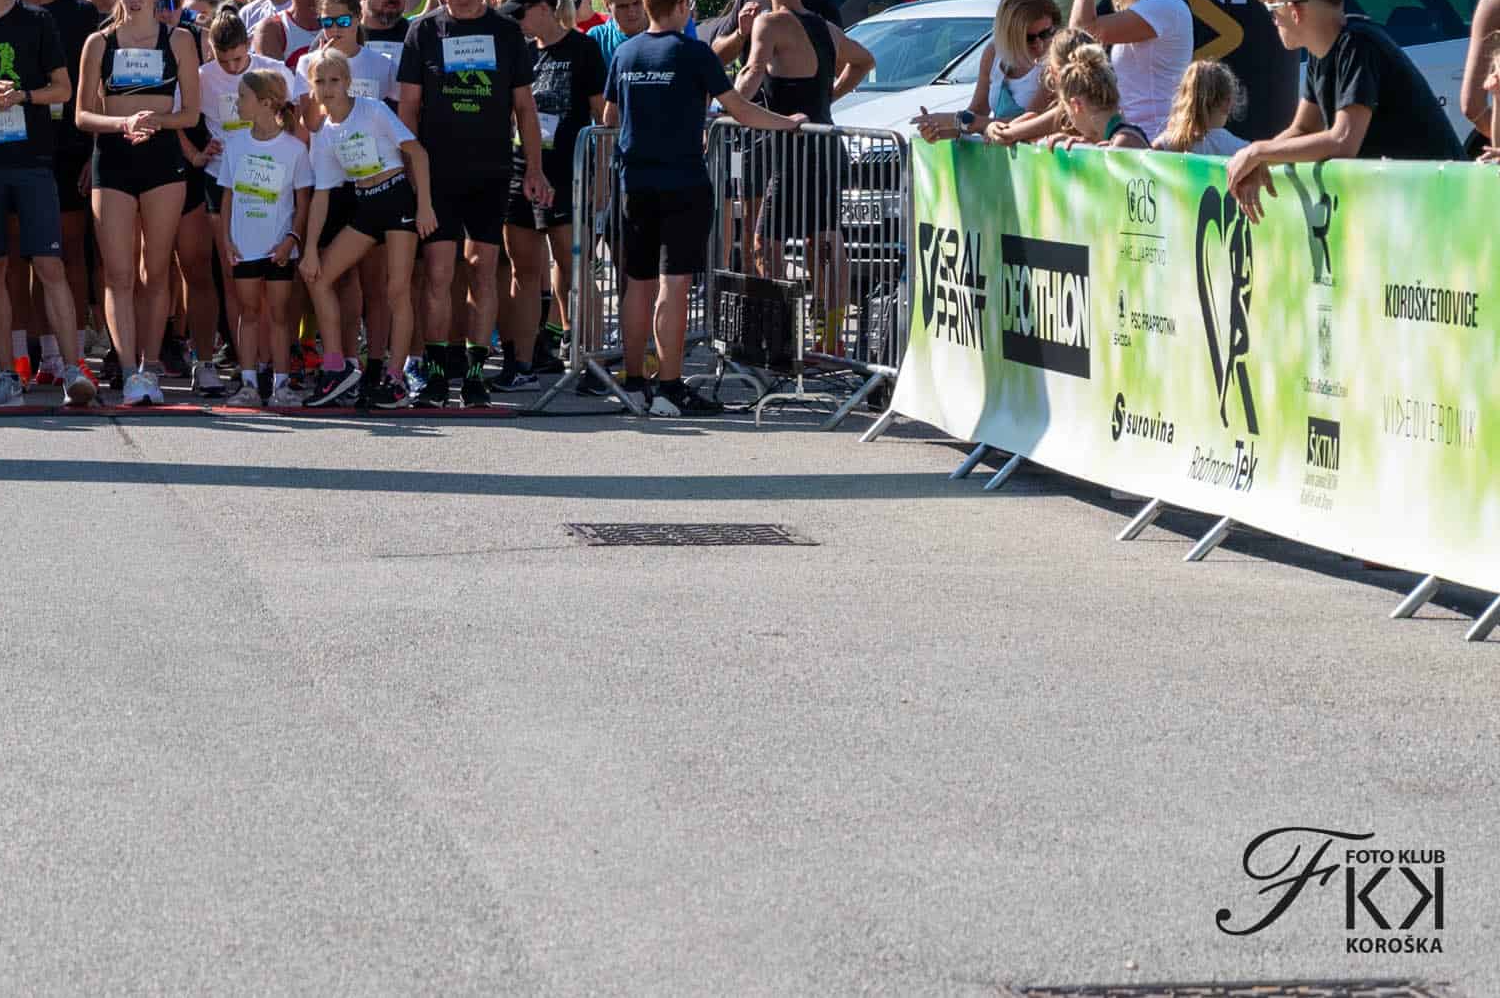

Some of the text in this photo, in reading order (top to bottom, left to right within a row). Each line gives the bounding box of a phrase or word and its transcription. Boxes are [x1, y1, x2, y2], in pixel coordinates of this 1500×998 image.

[935, 285, 988, 352] PRINT
[1002, 264, 1090, 349] DECATHLON
[1126, 411, 1175, 444] surovina
